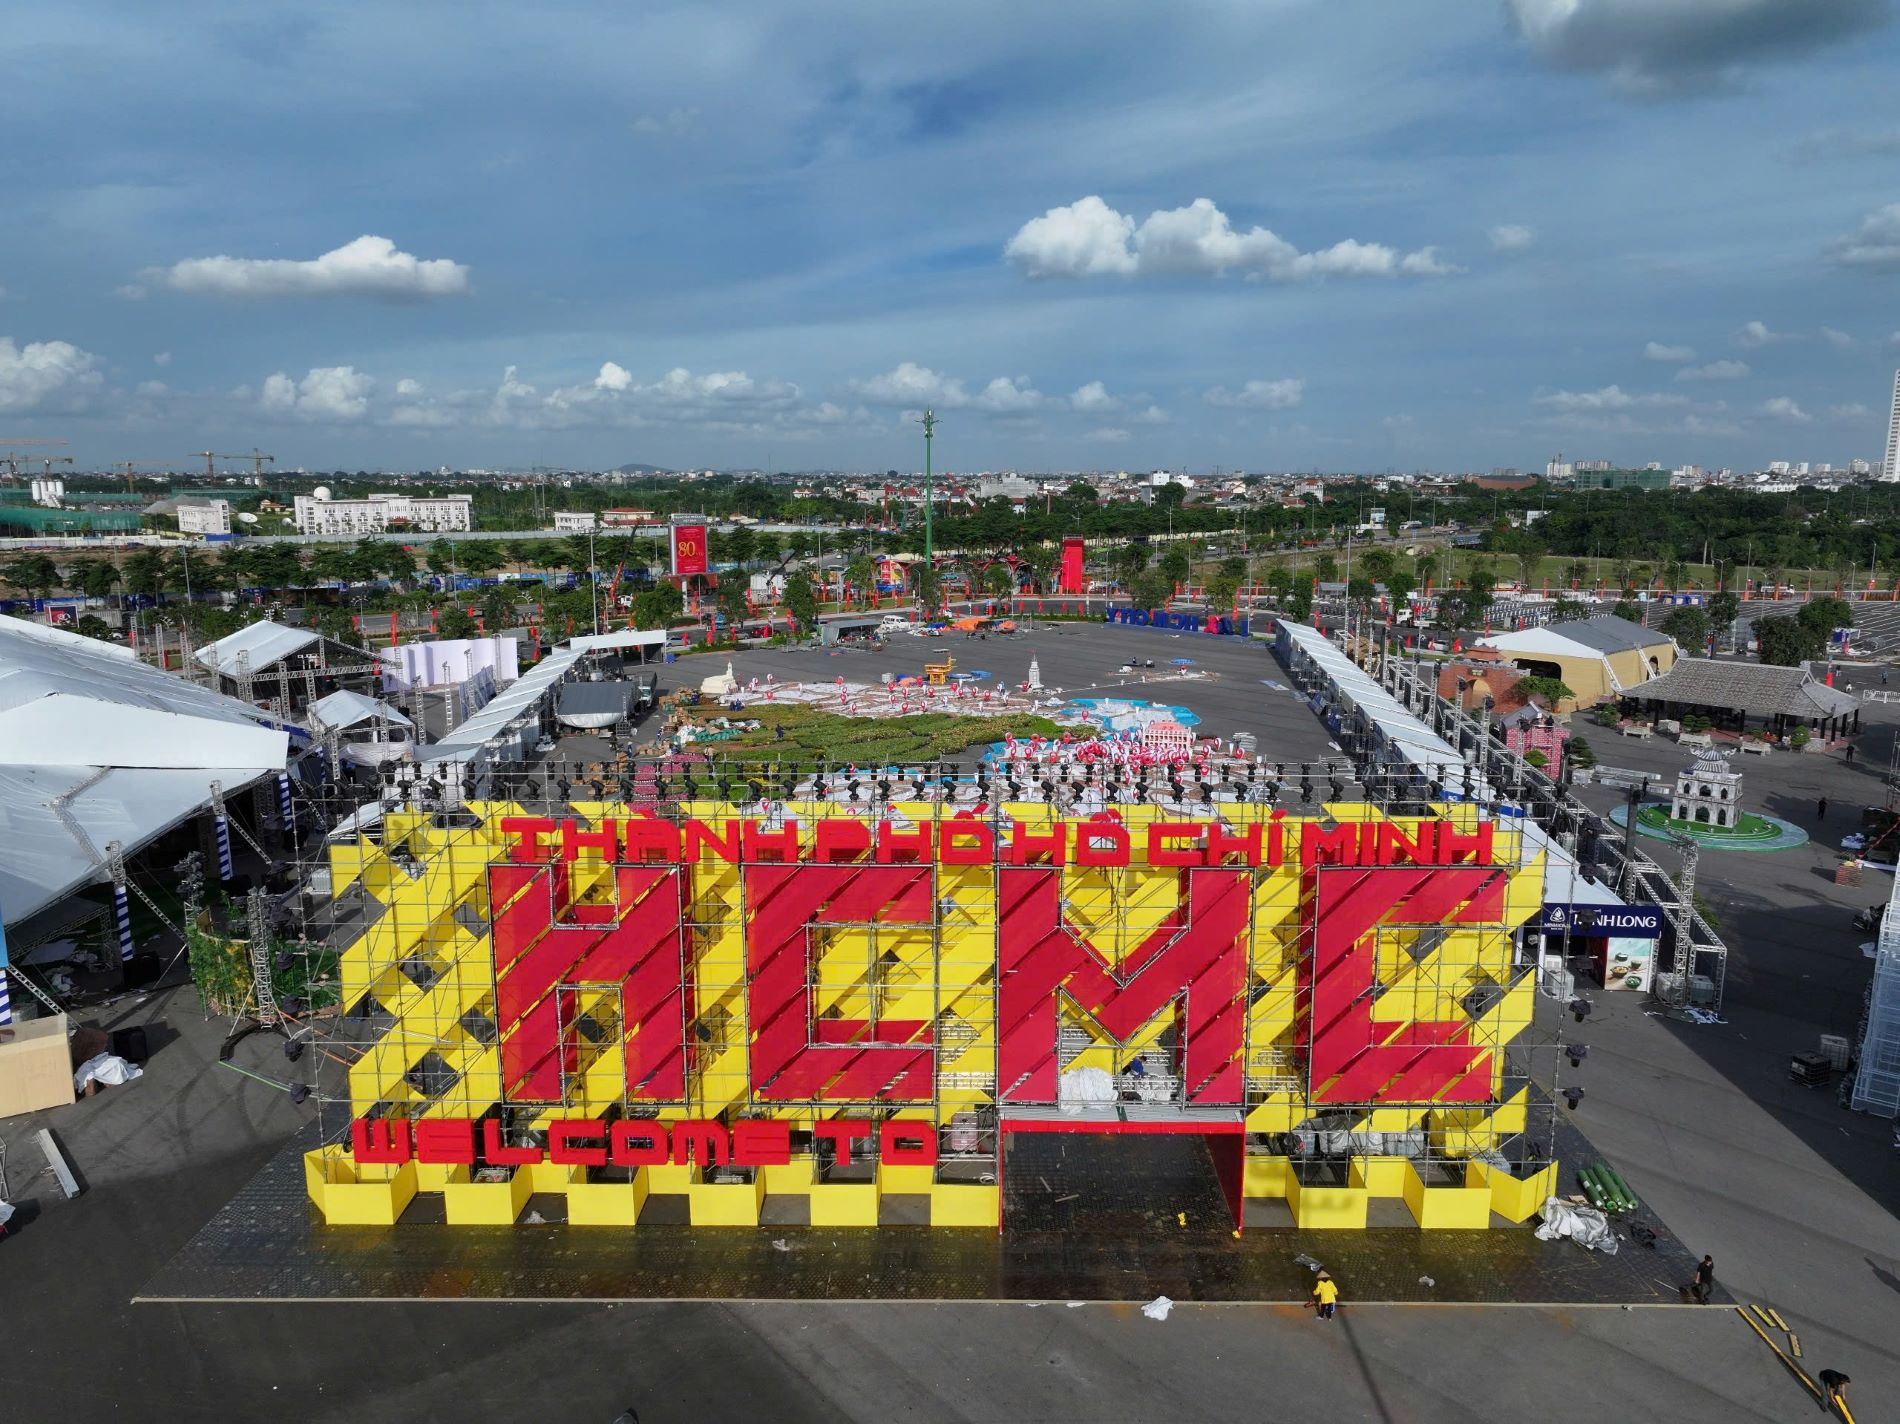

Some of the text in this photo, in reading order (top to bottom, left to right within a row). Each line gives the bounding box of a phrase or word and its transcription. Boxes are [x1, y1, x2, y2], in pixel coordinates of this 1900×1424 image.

[678, 541, 696, 556] 80
[500, 802, 1494, 866] THÀNH PHỐ HỒ CHÍ MINH
[1616, 914, 1657, 928] LONG
[487, 864, 1510, 1107] HCMC
[352, 1118, 937, 1166] WELCOME TO
